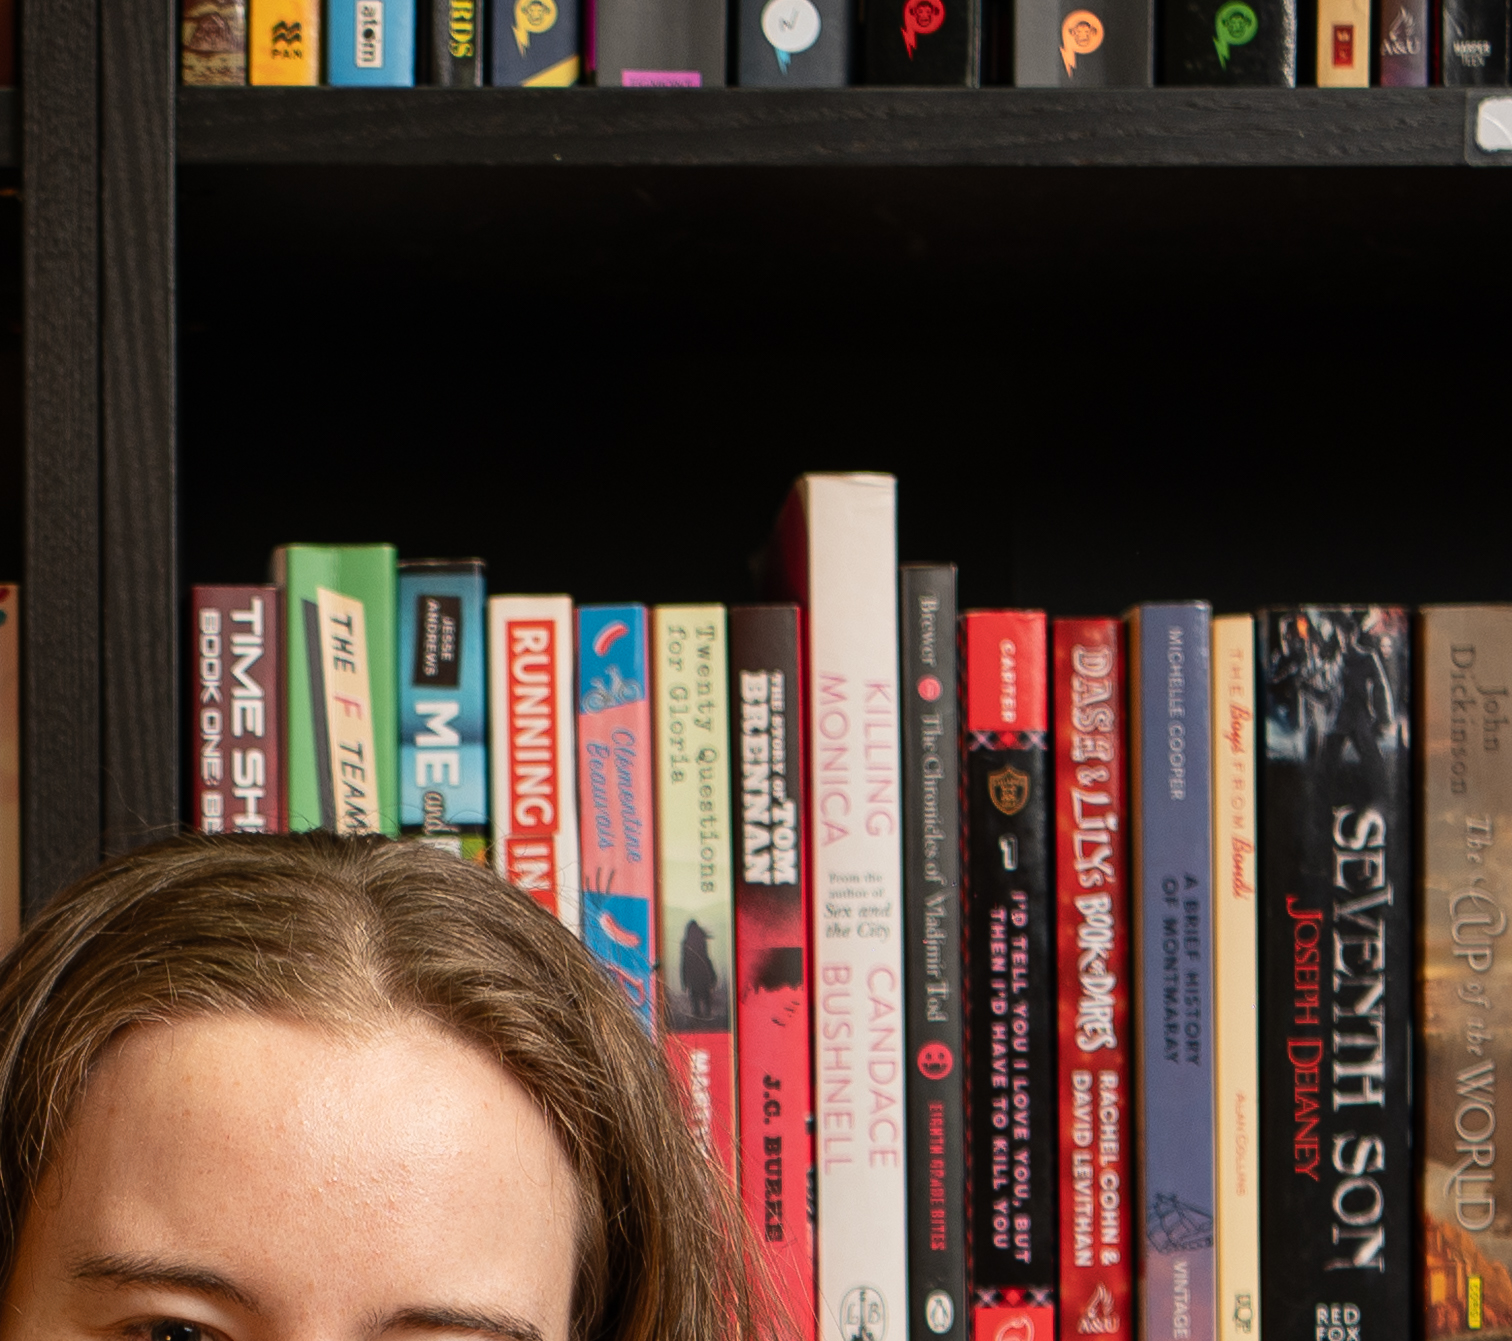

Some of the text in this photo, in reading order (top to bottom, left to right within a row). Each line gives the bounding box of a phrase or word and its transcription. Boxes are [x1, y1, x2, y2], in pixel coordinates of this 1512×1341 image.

[416, 701, 458, 788] ME
[512, 628, 551, 825] RUNNING
[668, 627, 688, 784] for Gloria
[694, 624, 717, 894] Twenty Questions
[819, 674, 852, 848] MONICA
[864, 681, 895, 838] KILLING
[824, 964, 853, 1175] BUSHNELL
[866, 964, 900, 1168] CANDACE
[1330, 806, 1393, 1273] SEVENTH SON
[1317, 1305, 1360, 1324] RED
